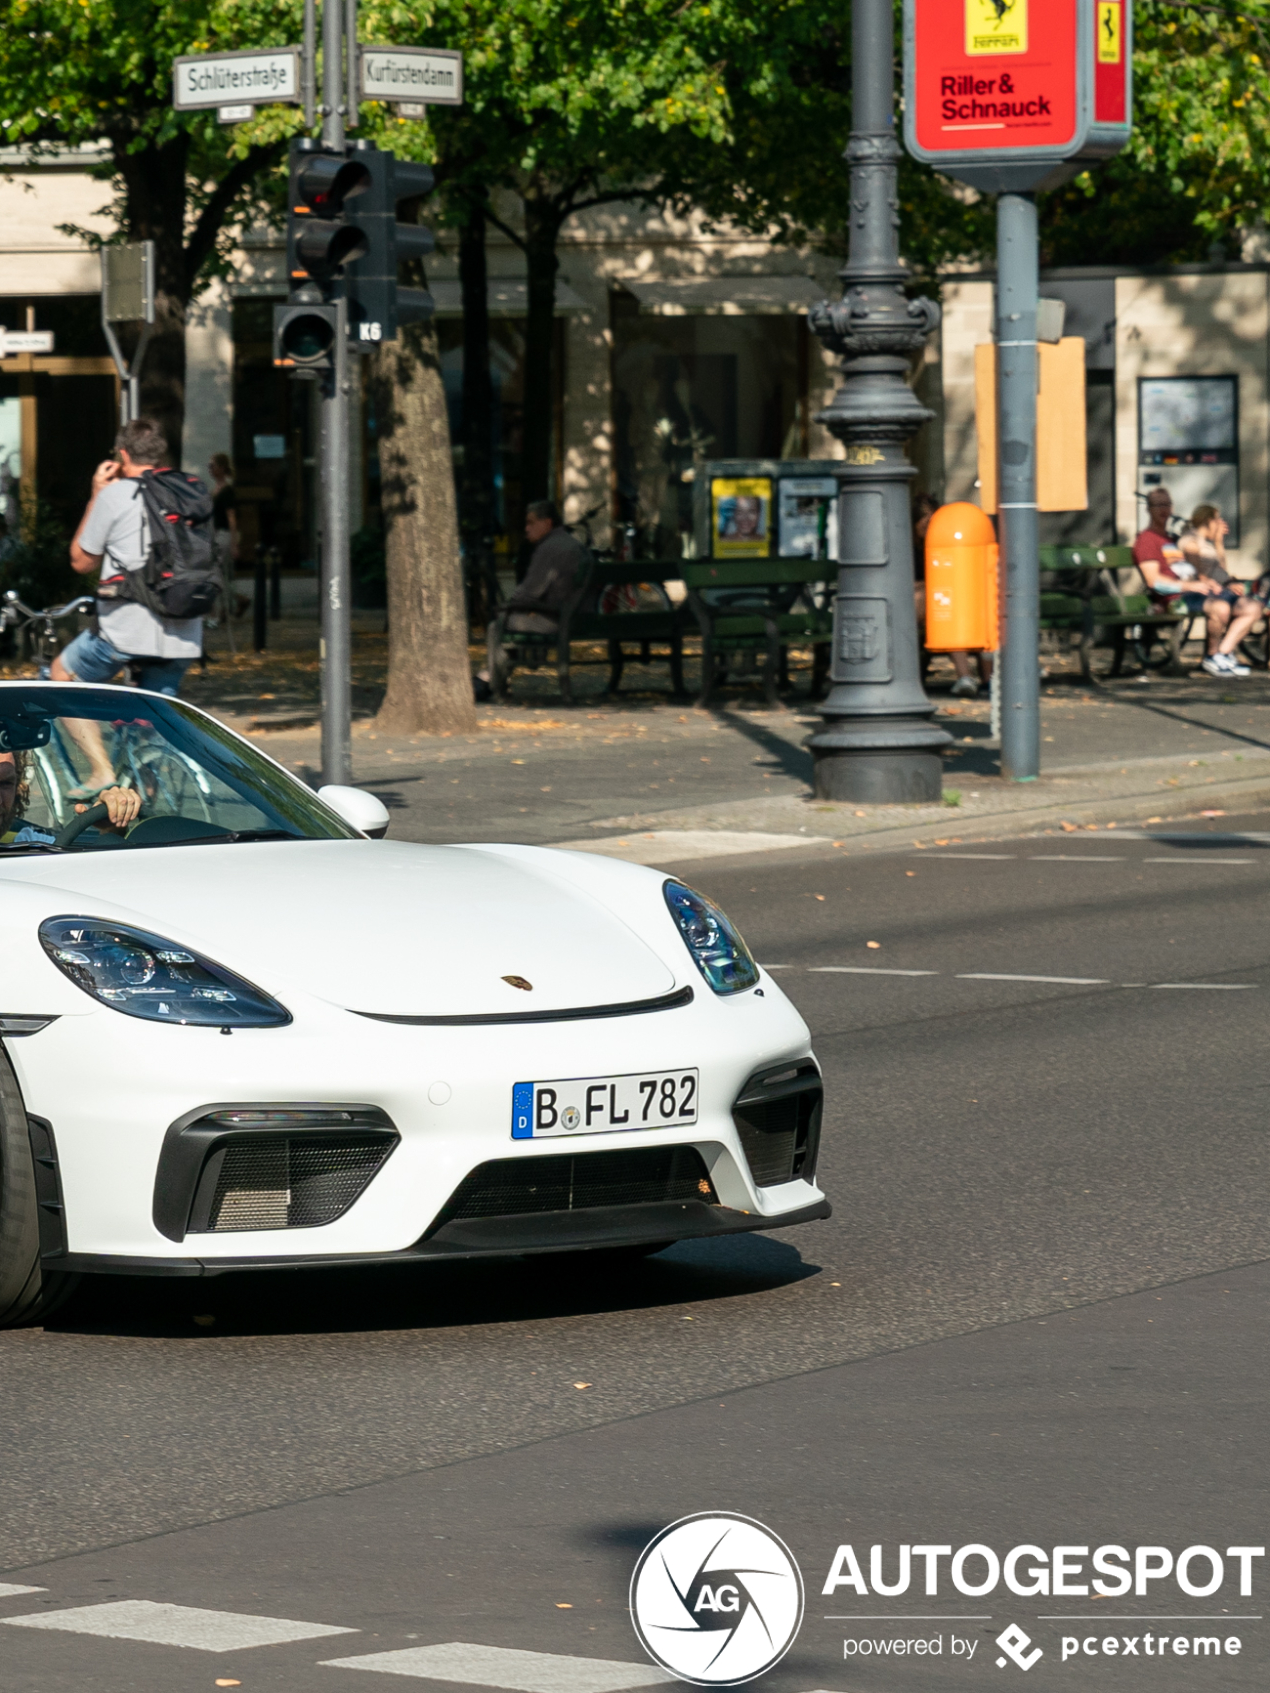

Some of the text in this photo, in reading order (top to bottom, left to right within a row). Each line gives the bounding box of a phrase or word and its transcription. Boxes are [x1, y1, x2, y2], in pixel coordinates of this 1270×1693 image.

[188, 62, 287, 92] Schlüterstraße
[366, 59, 454, 88] Kurfürstendamm
[941, 73, 1015, 96] Riller &
[941, 95, 1052, 120] Schnauck
[359, 322, 382, 340] K6
[536, 1075, 696, 1130] B FL 782
[518, 1116, 527, 1129] D
